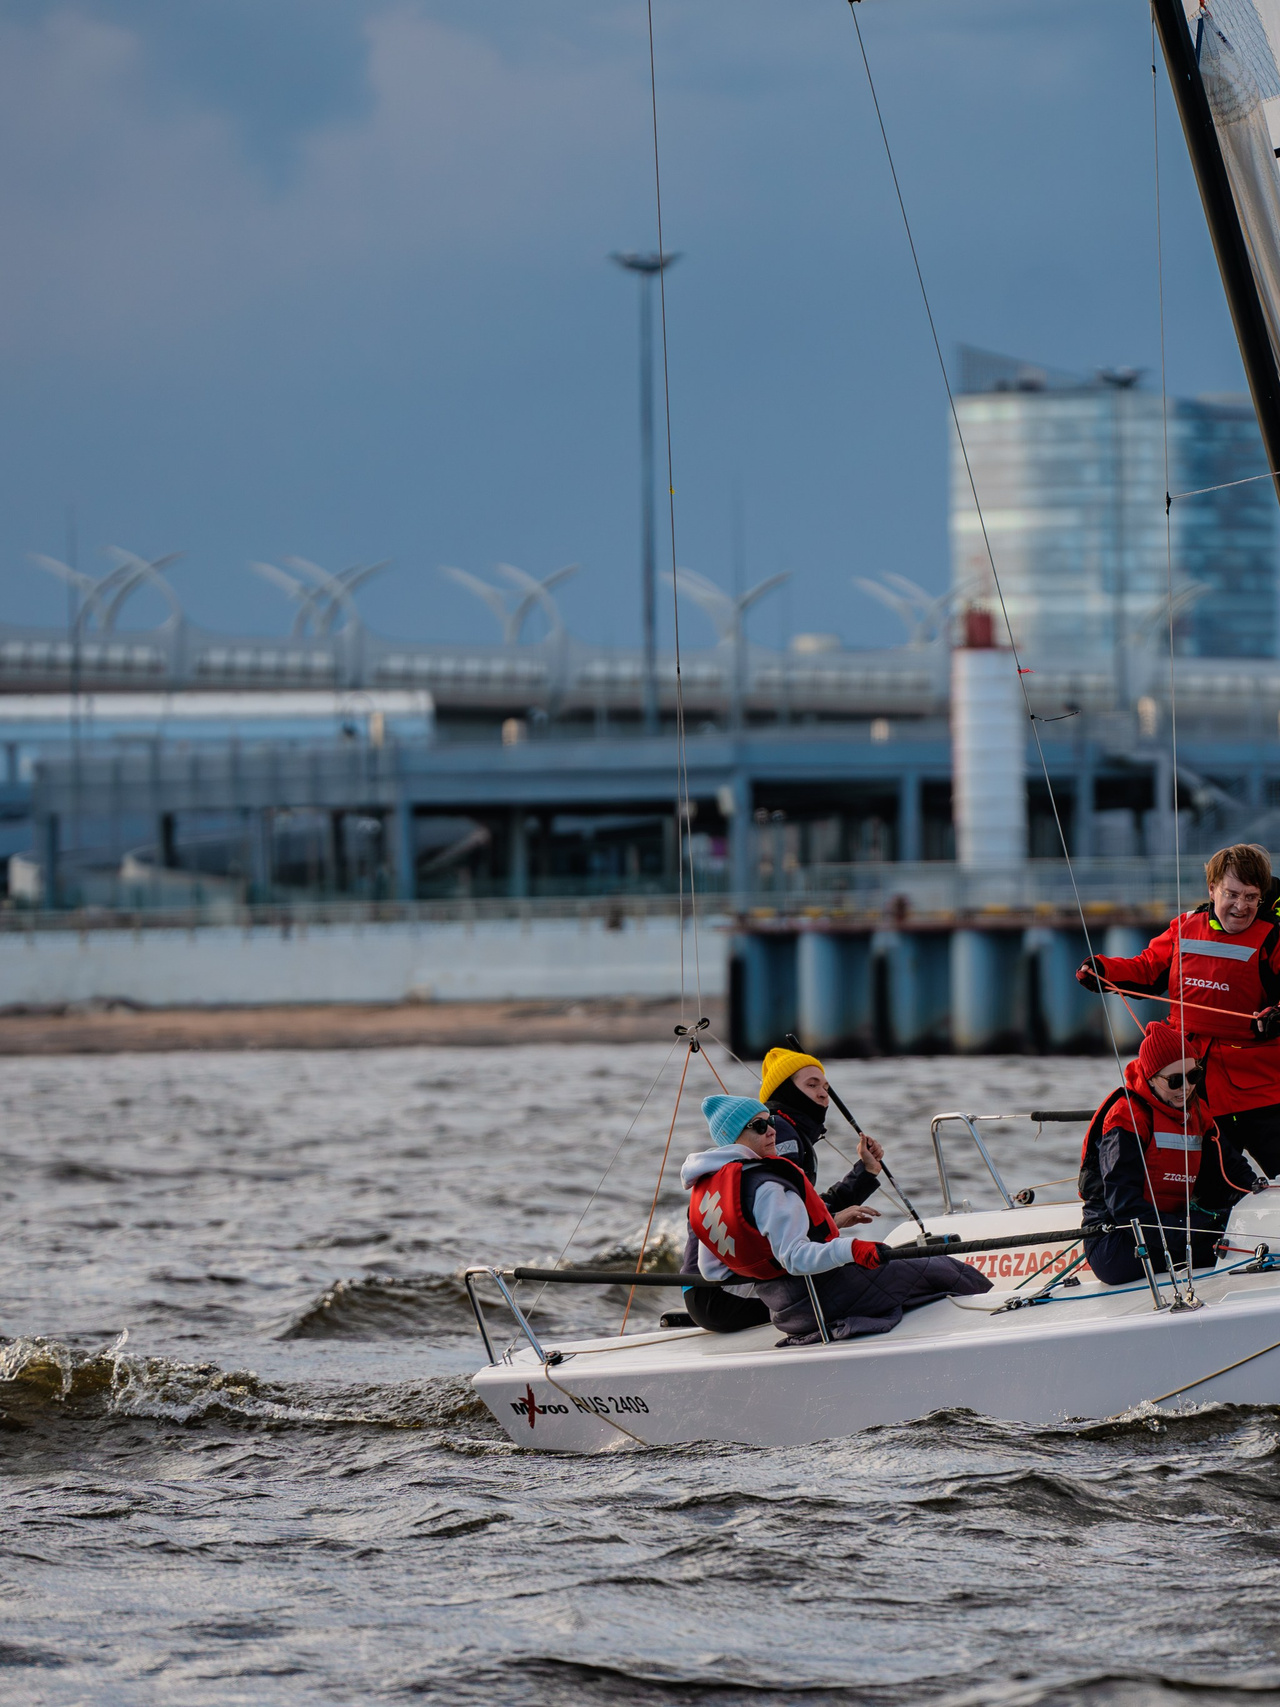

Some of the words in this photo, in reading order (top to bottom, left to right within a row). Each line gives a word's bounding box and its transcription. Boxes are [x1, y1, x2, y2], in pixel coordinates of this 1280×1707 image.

[1184, 977, 1230, 992] ZIGZAG
[1163, 1172, 1197, 1183] ZIGZAG
[569, 1395, 610, 1414] RUS
[608, 1395, 649, 1414] 2409
